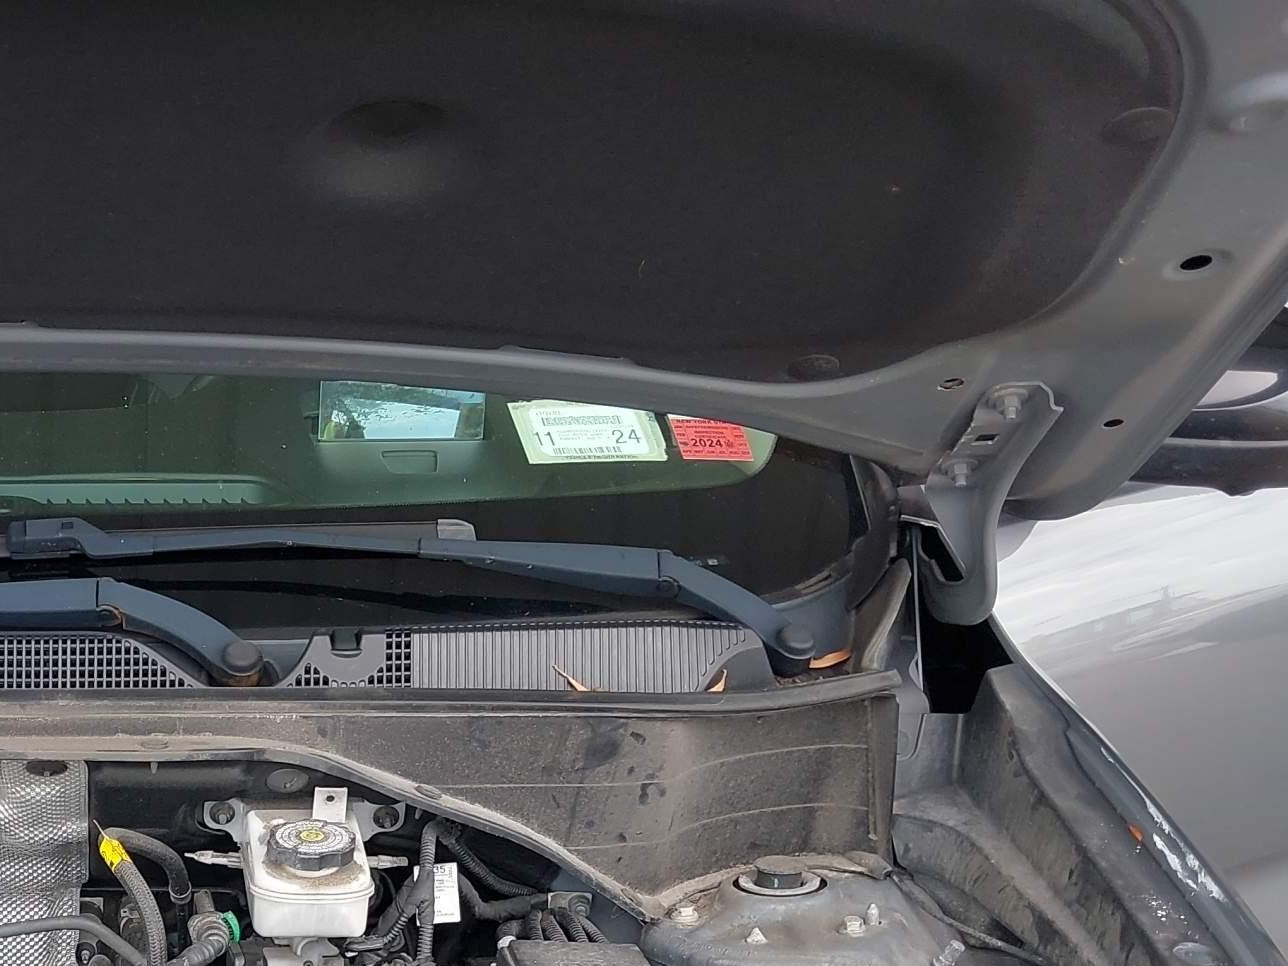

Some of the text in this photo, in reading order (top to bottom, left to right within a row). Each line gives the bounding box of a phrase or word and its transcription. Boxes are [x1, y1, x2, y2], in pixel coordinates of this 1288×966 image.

[533, 431, 556, 447] 11
[611, 429, 642, 445] 24
[690, 438, 723, 448] 2024
